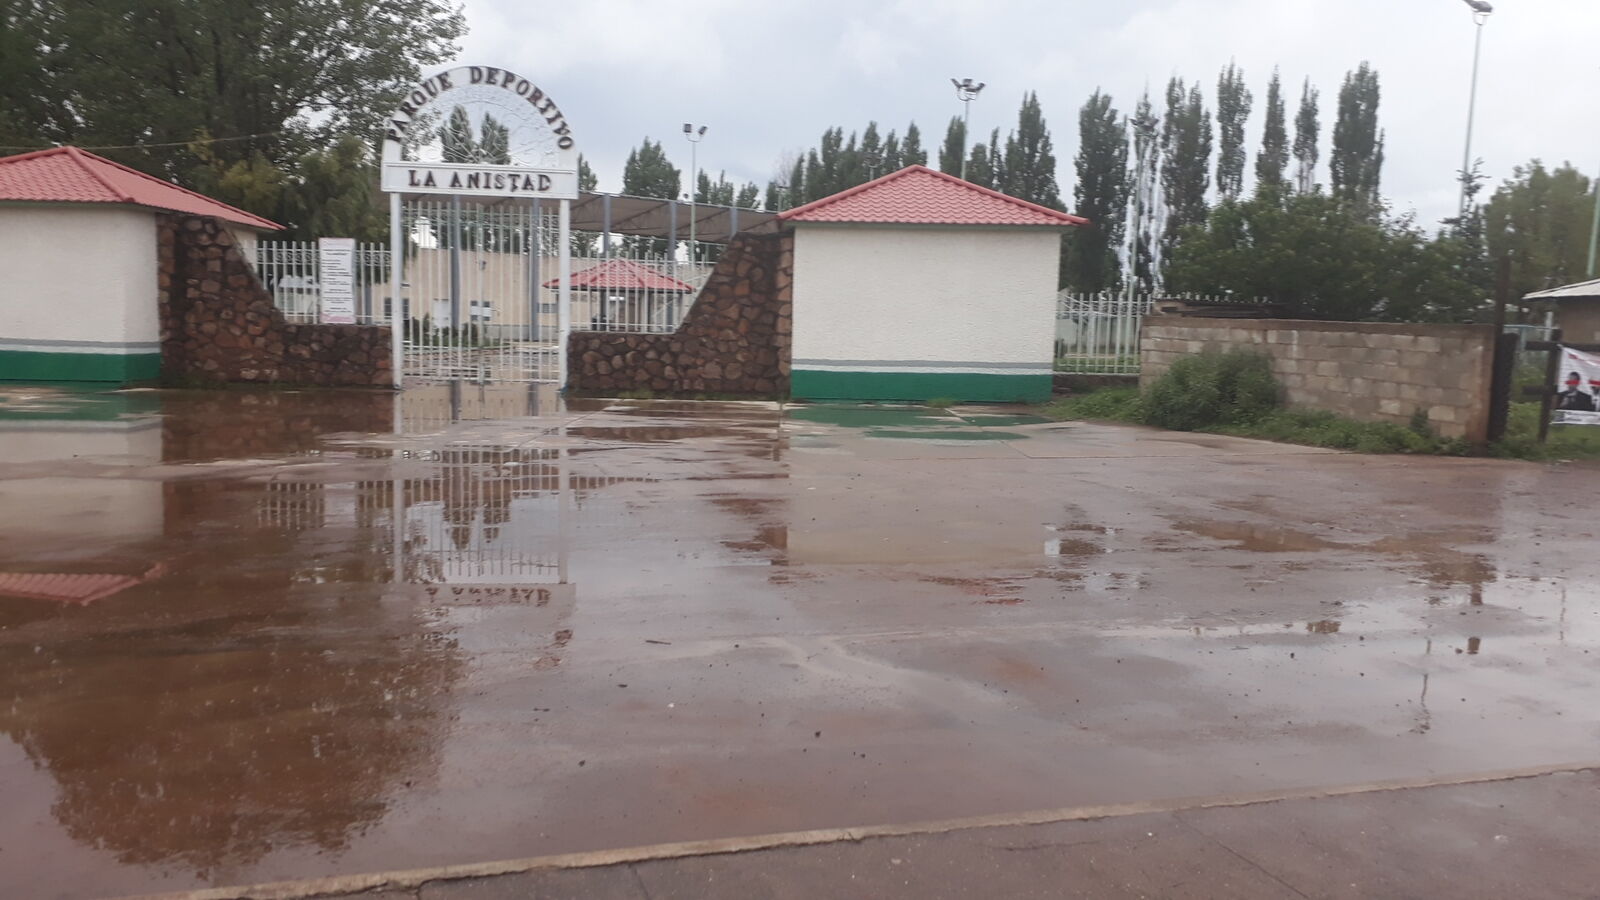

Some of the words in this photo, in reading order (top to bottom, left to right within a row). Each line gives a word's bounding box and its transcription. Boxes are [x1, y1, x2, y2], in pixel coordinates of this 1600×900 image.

[386, 72, 453, 142] PARQUE
[469, 66, 573, 150] DEPORTIVO
[408, 169, 437, 187] LA
